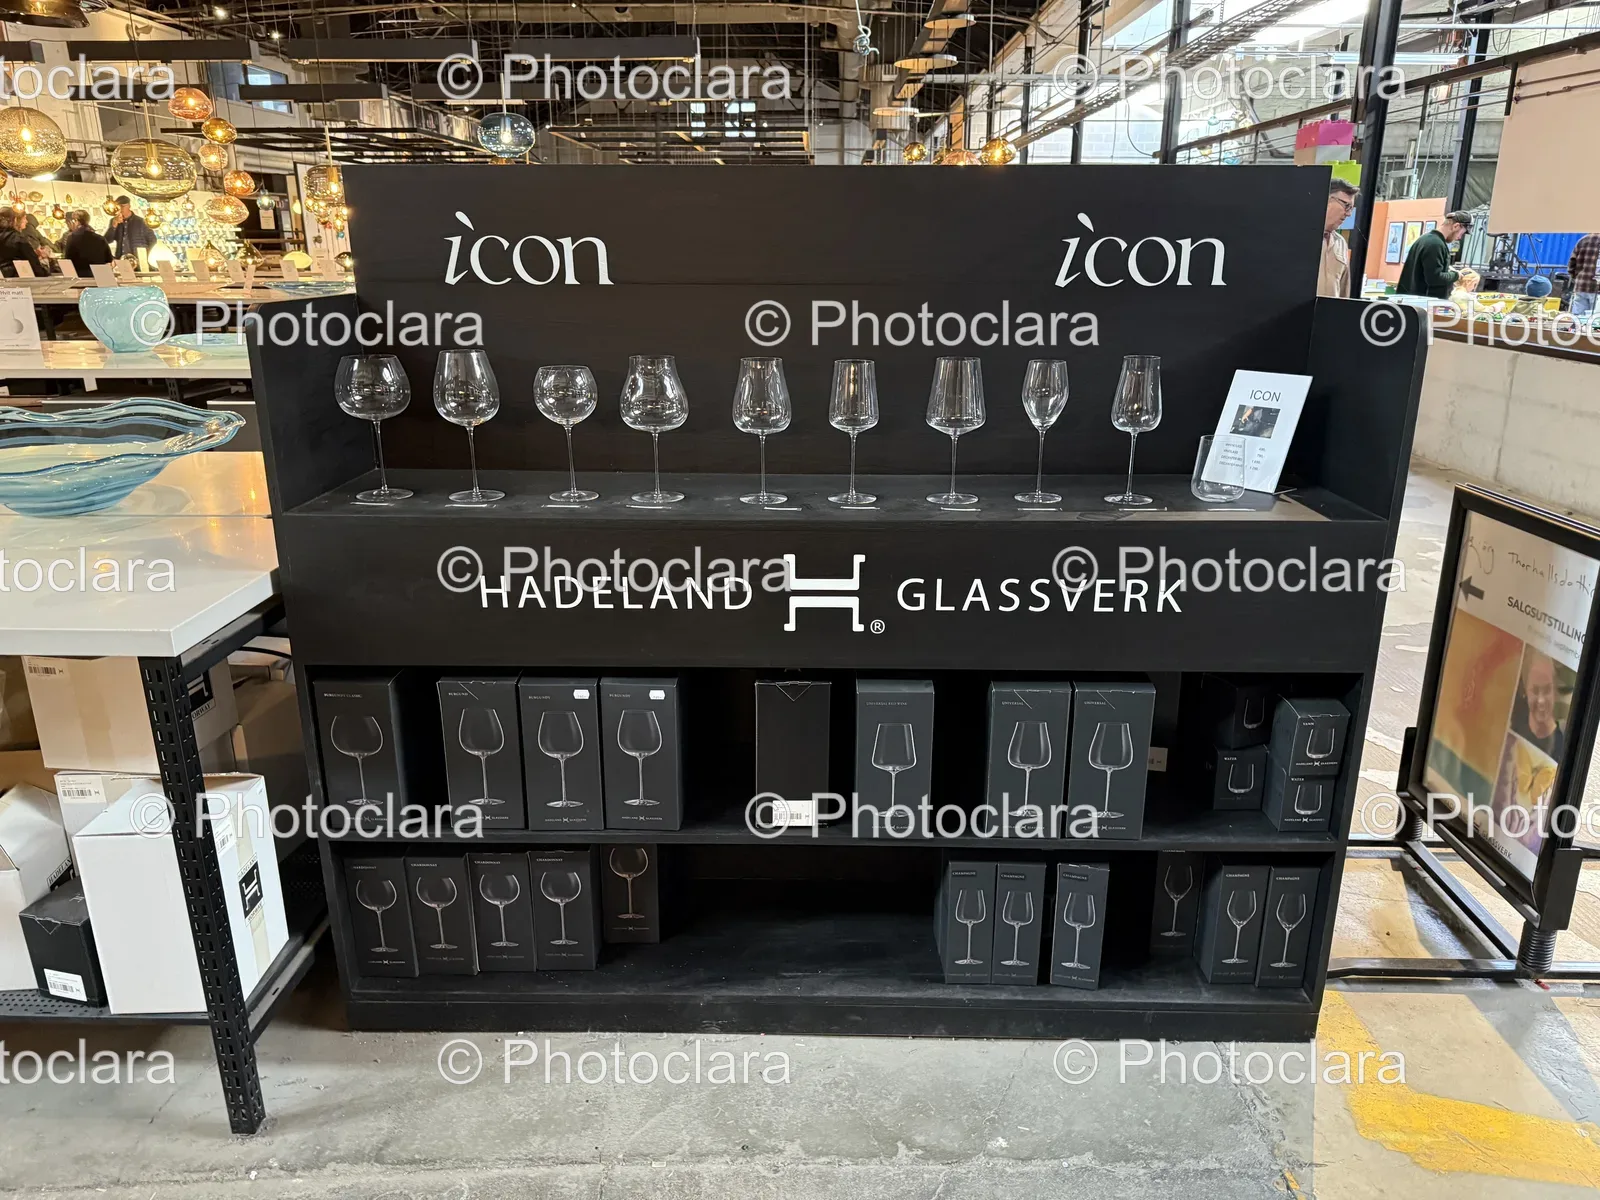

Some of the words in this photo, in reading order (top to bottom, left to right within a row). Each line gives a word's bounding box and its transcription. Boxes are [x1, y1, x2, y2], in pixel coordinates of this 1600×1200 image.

[1249, 389, 1282, 403] ICON
[479, 574, 753, 610] HADELAND
[896, 577, 1185, 613] GLASSVERK
[192, 702, 212, 719] ORWAY
[48, 857, 72, 885] HADELAN
